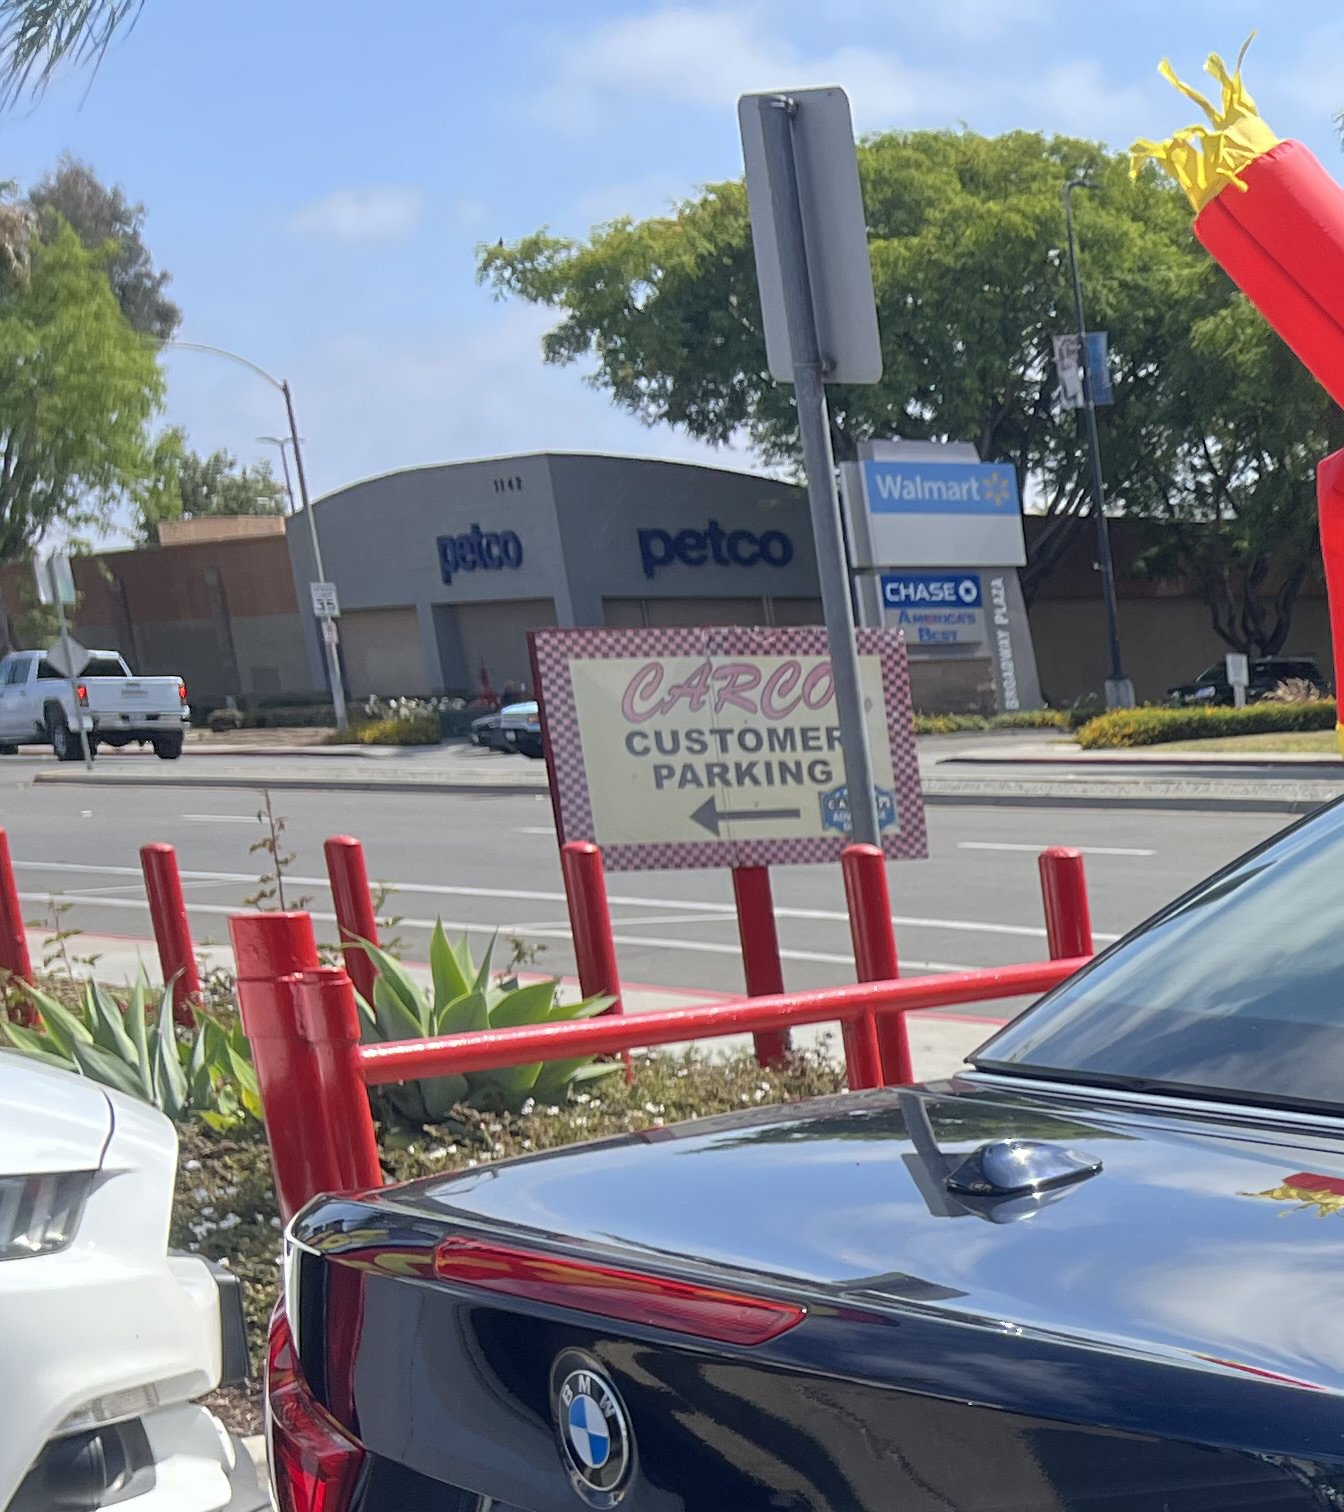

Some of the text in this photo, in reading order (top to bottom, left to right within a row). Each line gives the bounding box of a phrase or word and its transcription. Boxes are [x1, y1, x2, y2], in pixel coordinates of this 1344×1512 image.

[876, 474, 980, 500] Walmart
[436, 523, 523, 586] petco
[637, 518, 794, 579] petco
[316, 598, 336, 611] 35
[885, 582, 957, 602] CHASE
[621, 659, 836, 724] CARCO
[625, 727, 844, 756] CUSTOMER
[653, 760, 833, 789] PARKING
[561, 1374, 617, 1418] BMW
